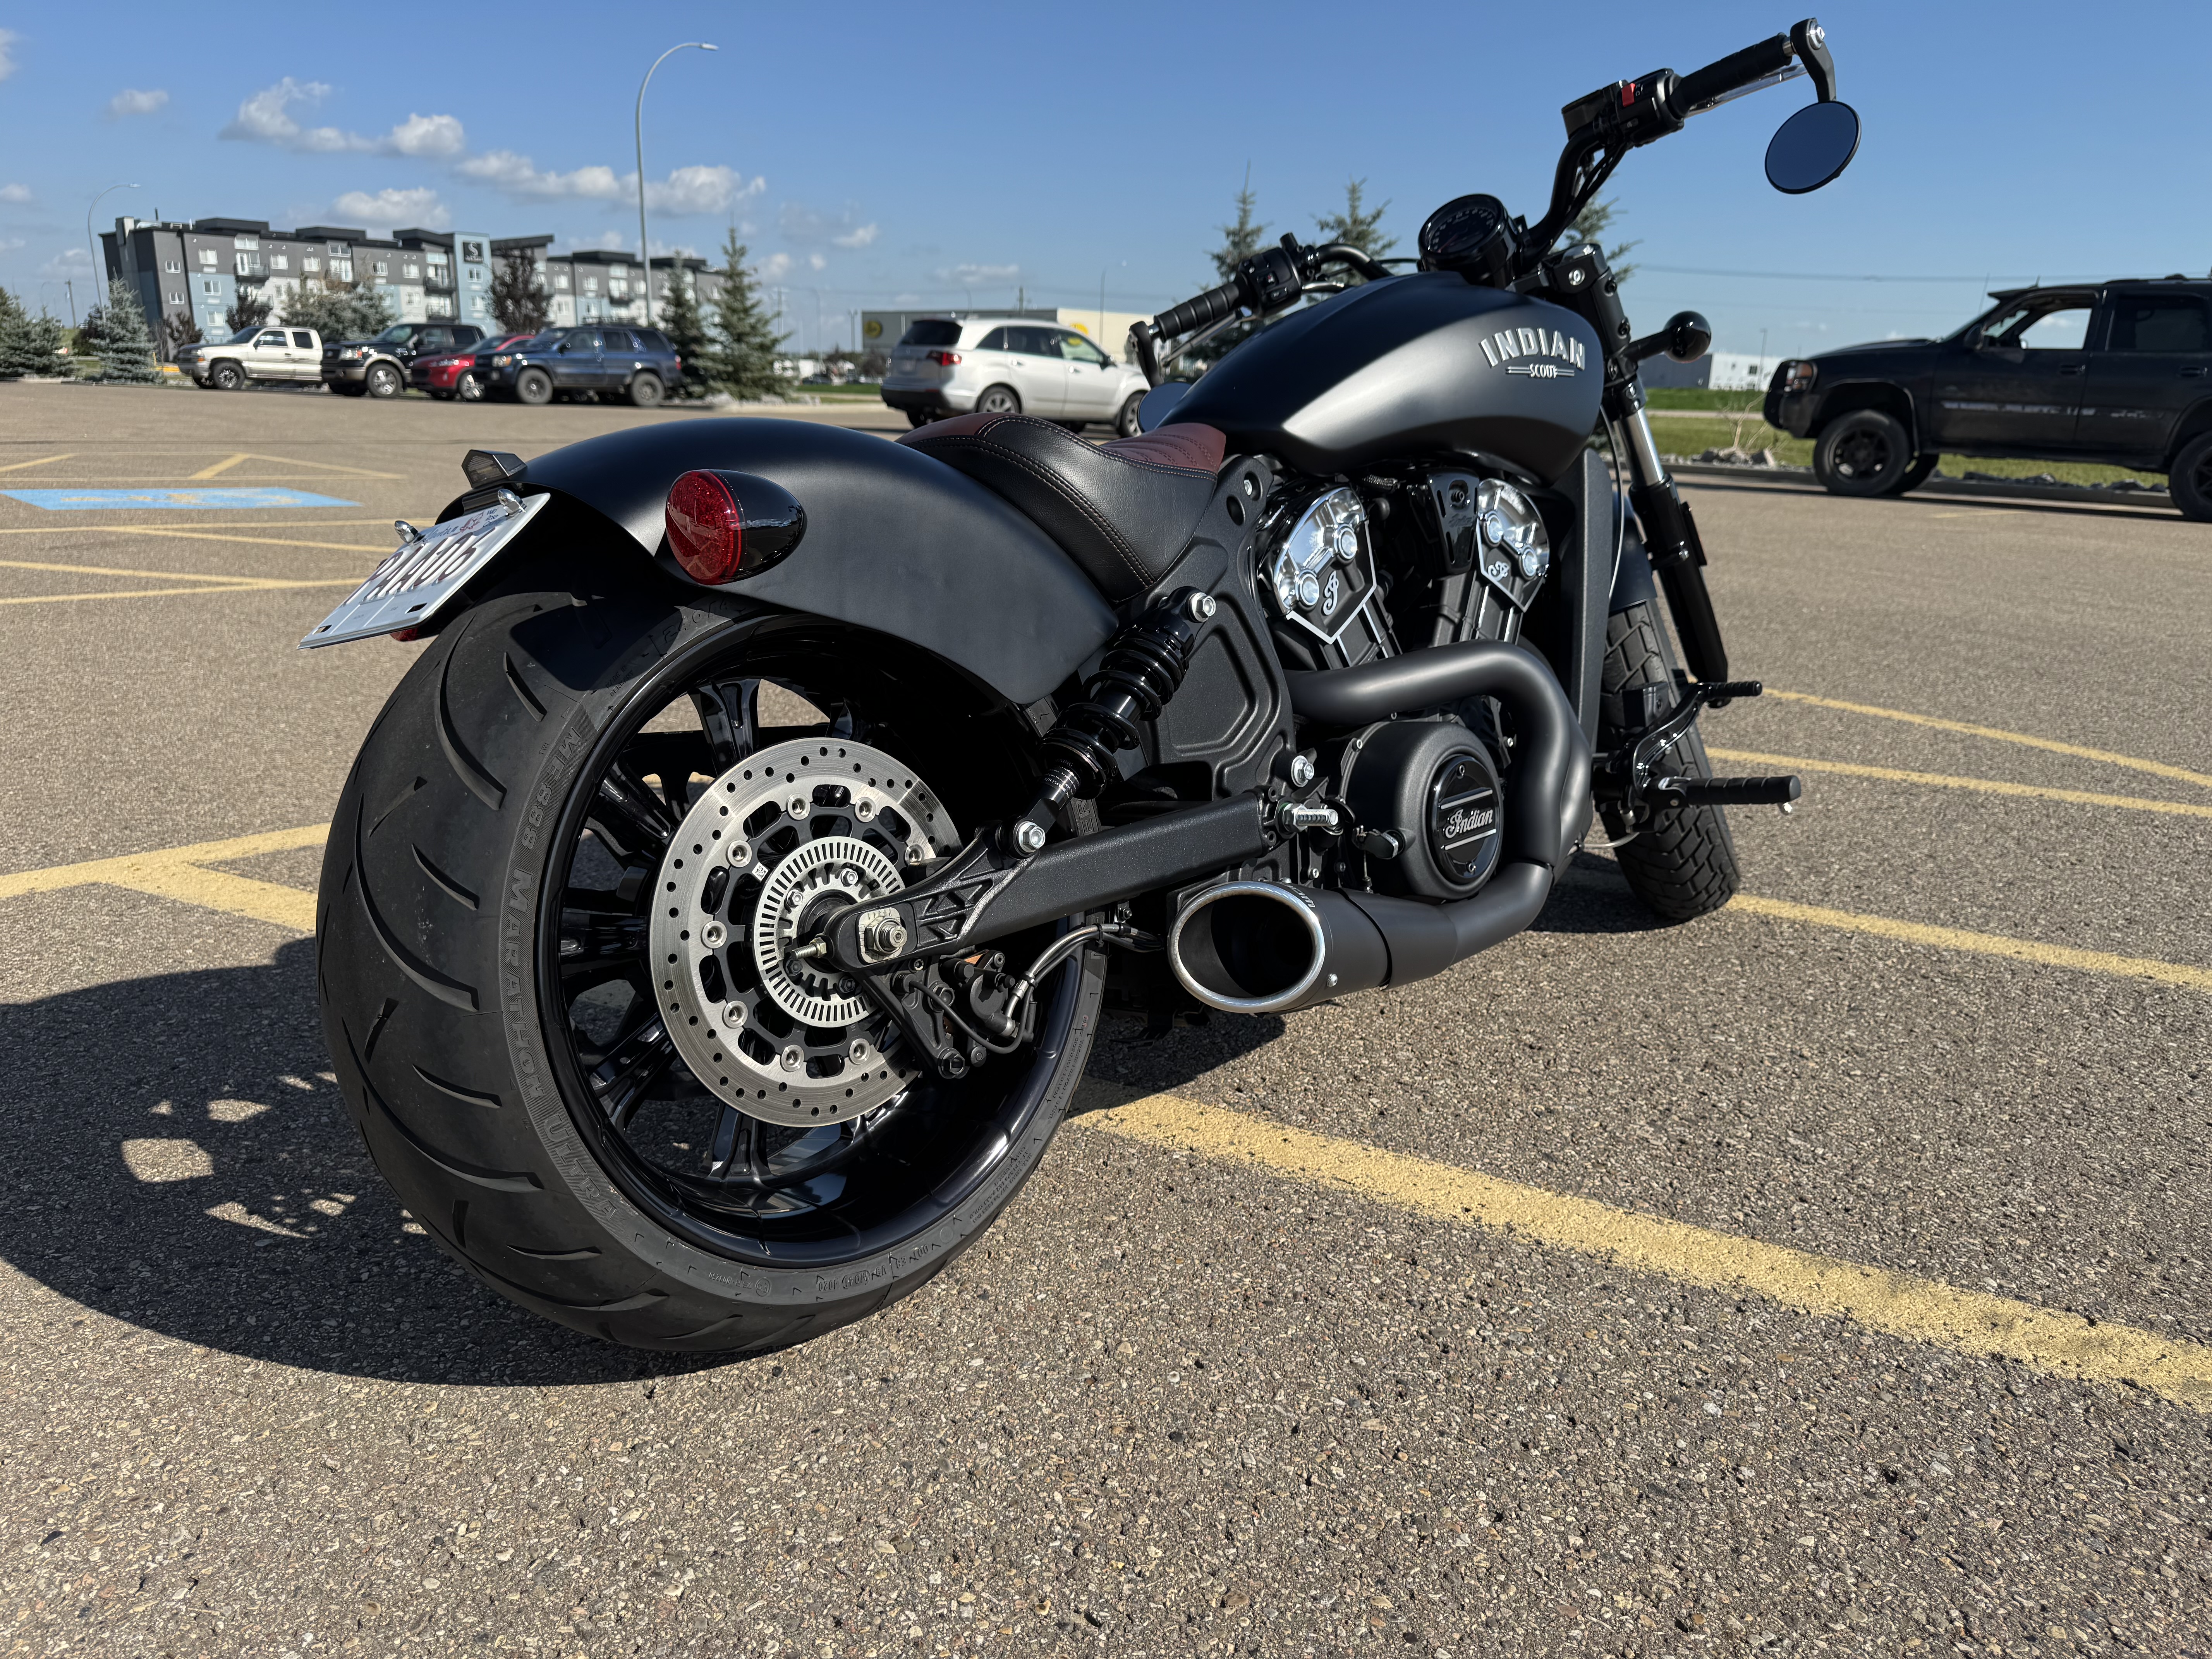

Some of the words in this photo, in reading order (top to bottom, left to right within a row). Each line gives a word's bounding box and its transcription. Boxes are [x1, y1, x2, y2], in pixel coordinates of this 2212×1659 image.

[1479, 328, 1585, 371] INDIAN
[1529, 363, 1558, 378] SCOUT
[547, 727, 581, 782] ME
[522, 783, 552, 849] 888
[1445, 809, 1493, 839] Indian
[506, 867, 544, 1098] MARATHON
[544, 1114, 618, 1221] ULTRA
